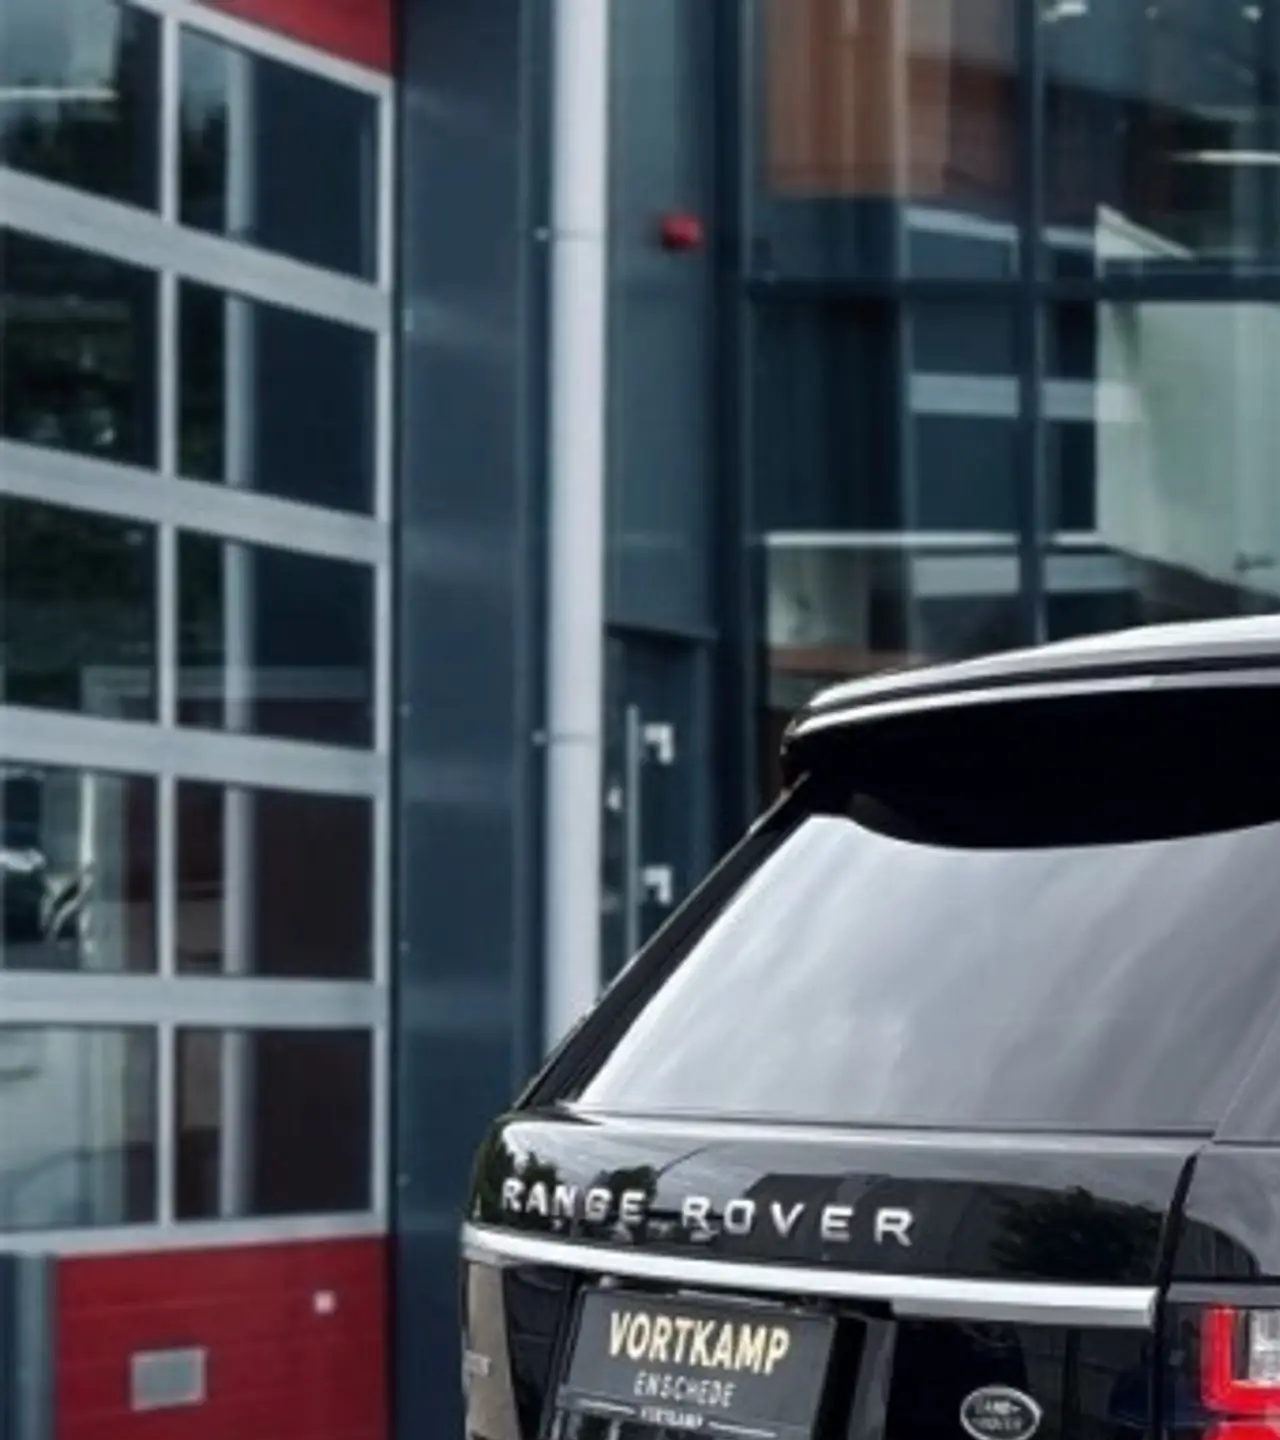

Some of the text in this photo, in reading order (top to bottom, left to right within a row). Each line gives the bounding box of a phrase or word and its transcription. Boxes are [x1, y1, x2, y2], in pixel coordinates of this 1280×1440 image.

[501, 1178, 915, 1246] RANGE ROVER
[608, 1310, 791, 1376] VORTKAMP
[633, 1370, 736, 1408] ENSCHEDE
